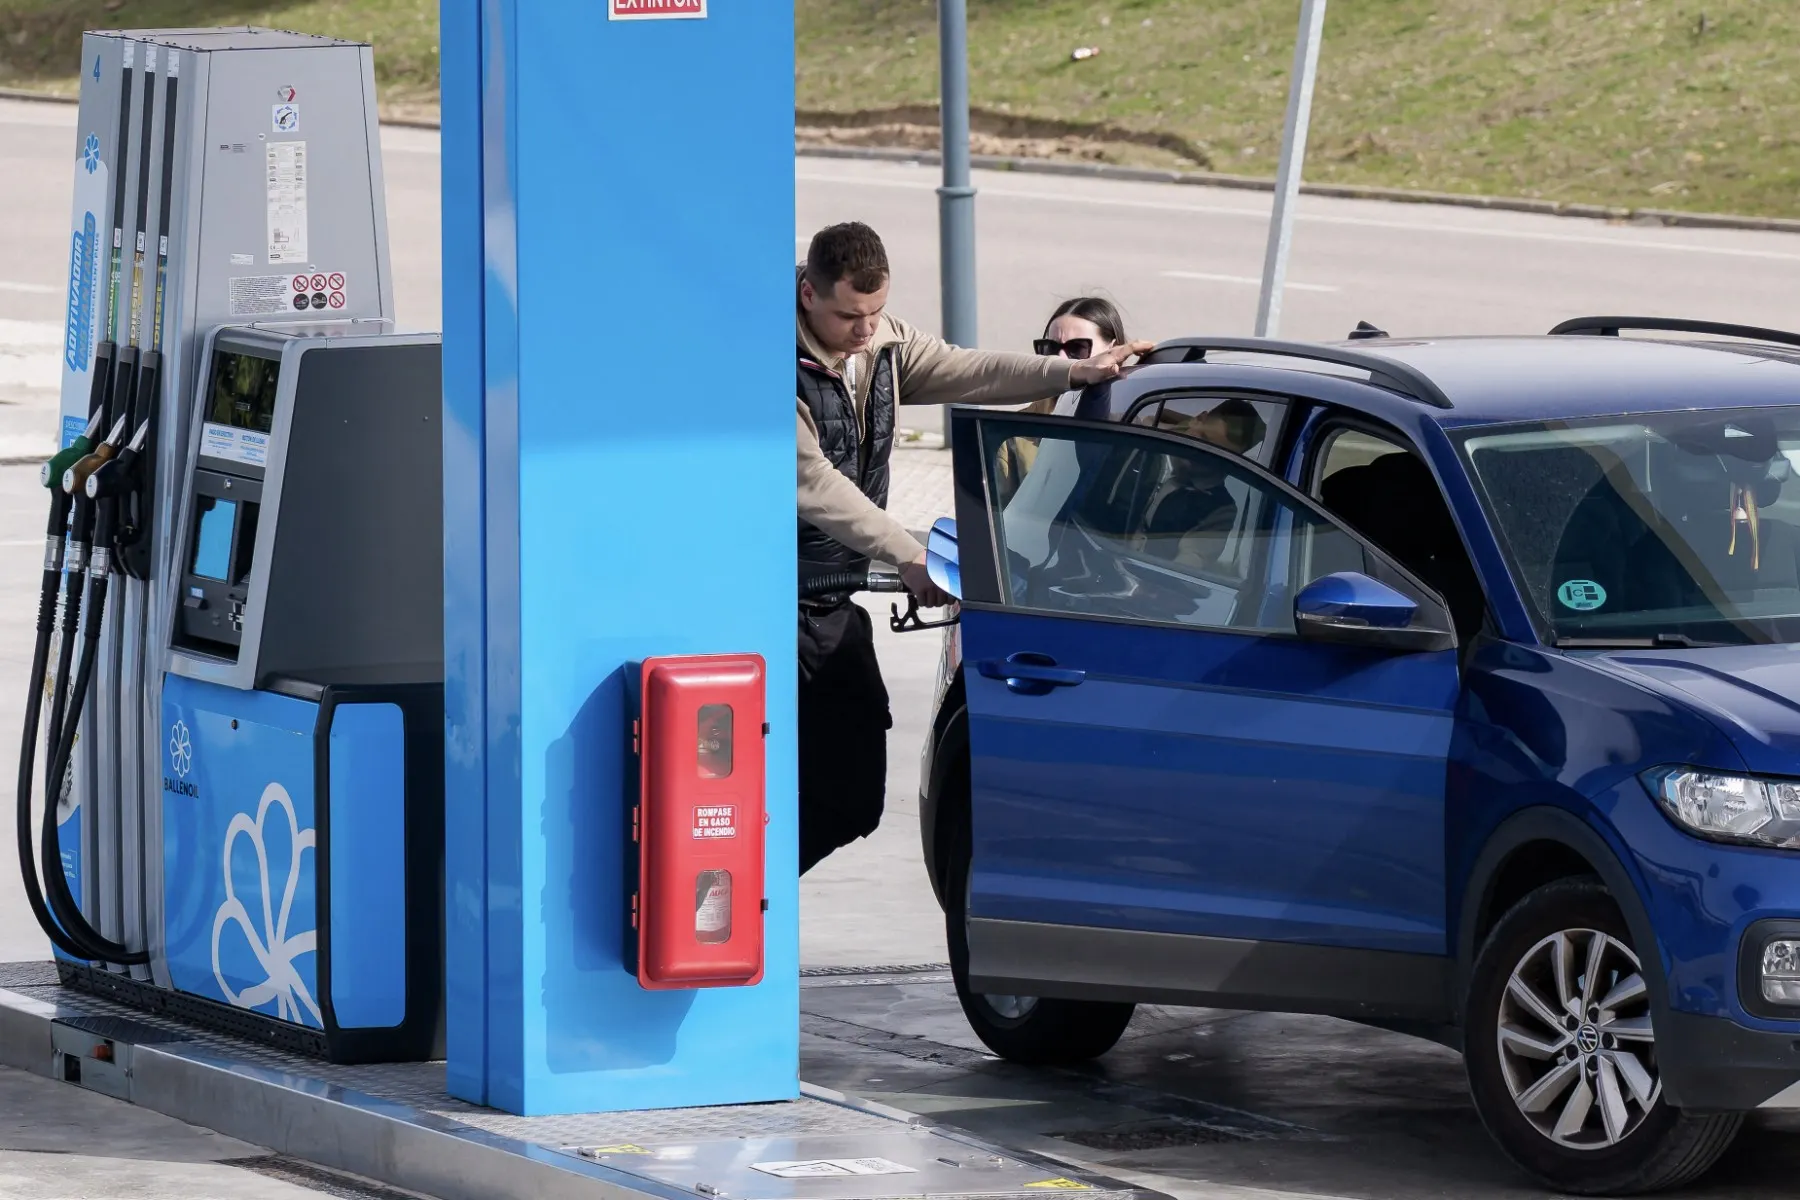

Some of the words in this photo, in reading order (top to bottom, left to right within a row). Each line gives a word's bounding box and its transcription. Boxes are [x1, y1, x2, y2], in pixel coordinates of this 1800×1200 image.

[93, 54, 100, 83] 4
[68, 237, 83, 365] ADITIVADOR
[107, 271, 115, 335] GASOLINA
[130, 281, 139, 339] DIESEL
[154, 285, 162, 344] DIESEL
[164, 777, 199, 799] BALLENOIL
[697, 808, 732, 817] ROMPASE
[699, 818, 709, 827] EN
[694, 828, 703, 837] DE
